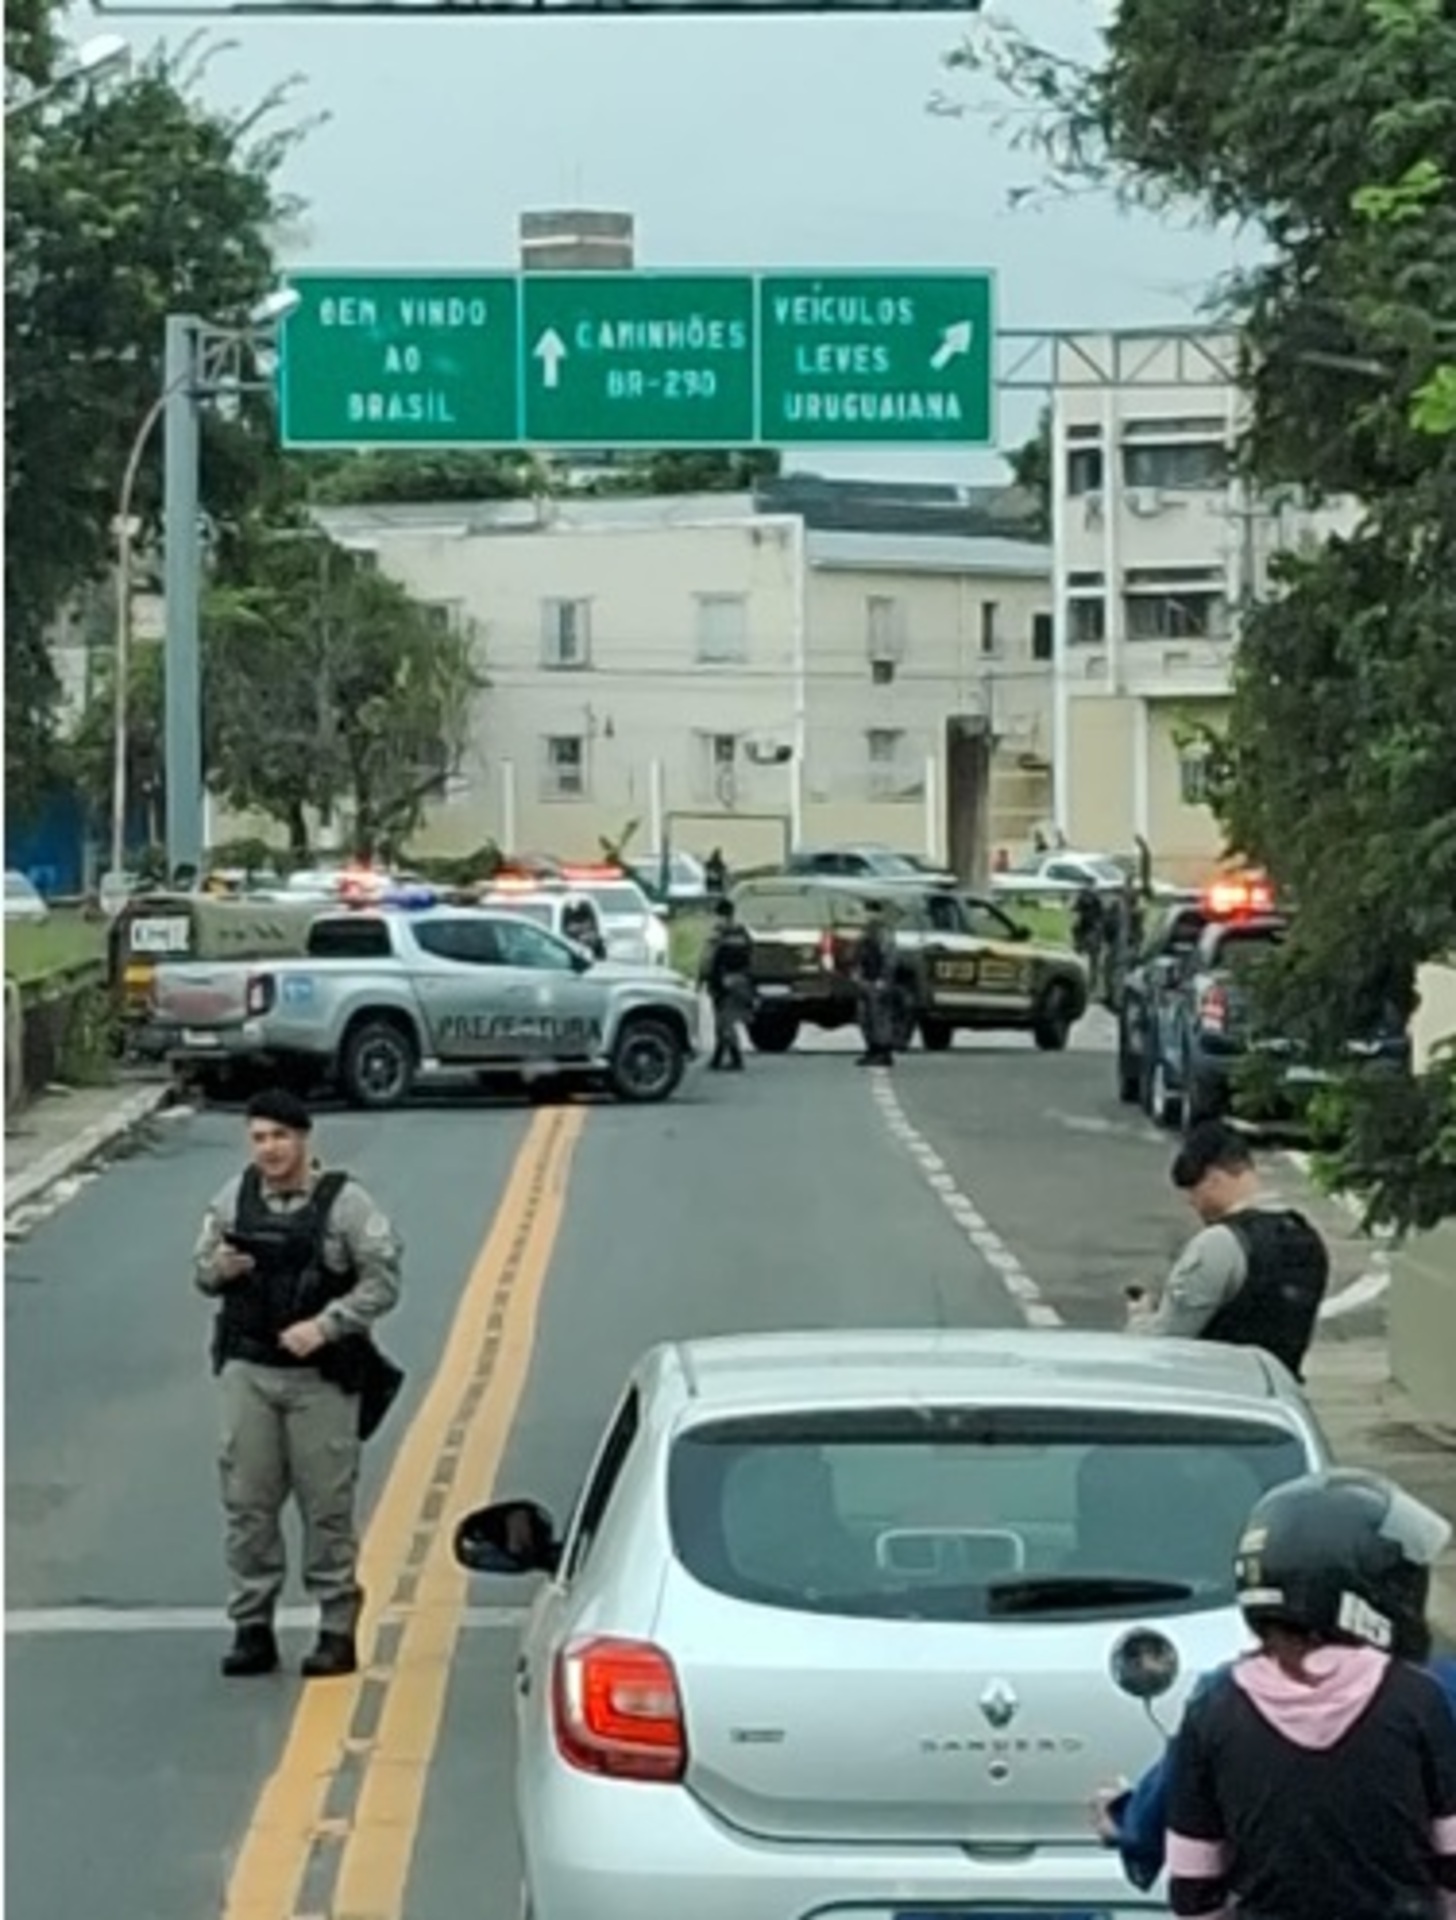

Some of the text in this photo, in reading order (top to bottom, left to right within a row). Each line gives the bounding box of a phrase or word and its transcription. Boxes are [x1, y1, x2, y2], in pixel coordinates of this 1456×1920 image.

[319, 297, 487, 325] BEM VINDO
[774, 282, 914, 324] VEÍCULOS
[575, 313, 746, 349] CAMINHÕES
[384, 345, 422, 373] AO
[795, 345, 890, 373] LEVES
[607, 369, 717, 398] BR-290
[348, 391, 455, 423] BRASIL
[784, 392, 962, 420] URUGUAIANA
